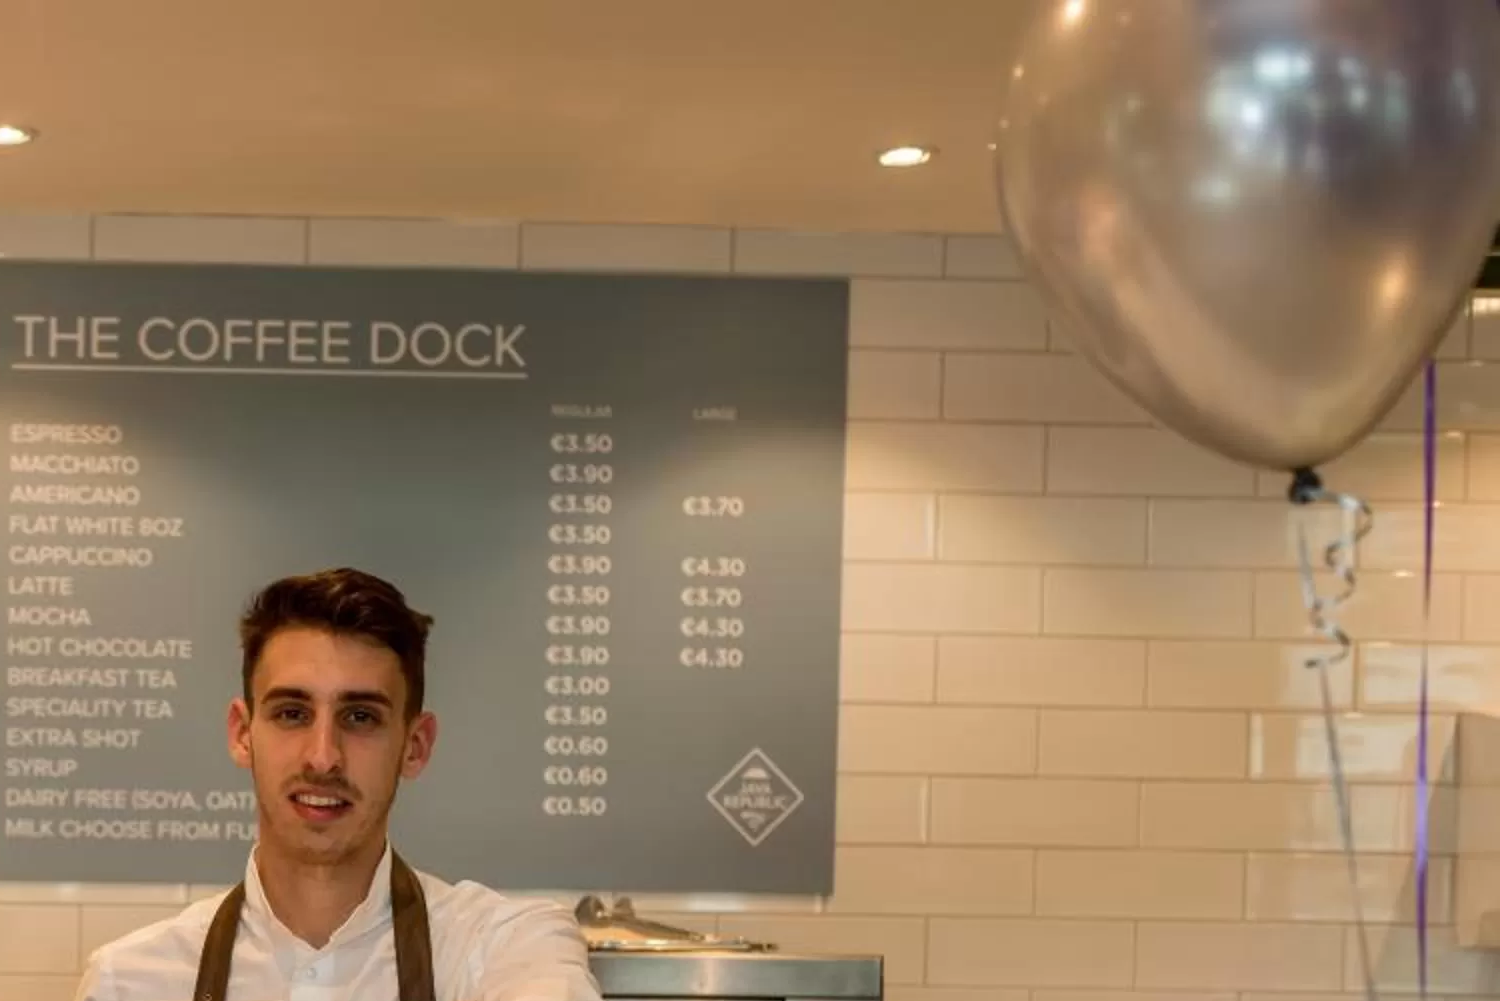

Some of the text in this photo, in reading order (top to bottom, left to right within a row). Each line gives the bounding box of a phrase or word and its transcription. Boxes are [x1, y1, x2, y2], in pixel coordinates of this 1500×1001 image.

[13, 315, 526, 367] THE COFFEE DOCK
[692, 407, 737, 421] LARGE
[9, 423, 123, 445] ESPRESSO
[550, 433, 613, 453] €3.50
[9, 454, 140, 476] MACCHIATO
[9, 484, 141, 506] AMERICANO
[8, 515, 60, 535] FLAT
[65, 515, 134, 537] WHITE
[548, 523, 611, 545] €3.50
[8, 545, 153, 568] CAPPUCCINO
[7, 575, 73, 597] LATTE
[546, 584, 610, 606] €3.50
[7, 606, 92, 627] MOCHA
[7, 636, 193, 659] HOT CHOCOLATE
[6, 666, 177, 689] BREAKFAST TEA
[544, 675, 610, 696] €3.00
[5, 696, 173, 719] SPECIALITY TEA
[5, 727, 141, 749] EXTRA SHOT
[4, 757, 78, 778] SYRUP
[5, 787, 69, 807] DAIRY
[73, 788, 127, 809] FREE
[4, 818, 54, 838] MILK
[58, 819, 152, 840] CHOOSE
[157, 819, 221, 841] FROM
